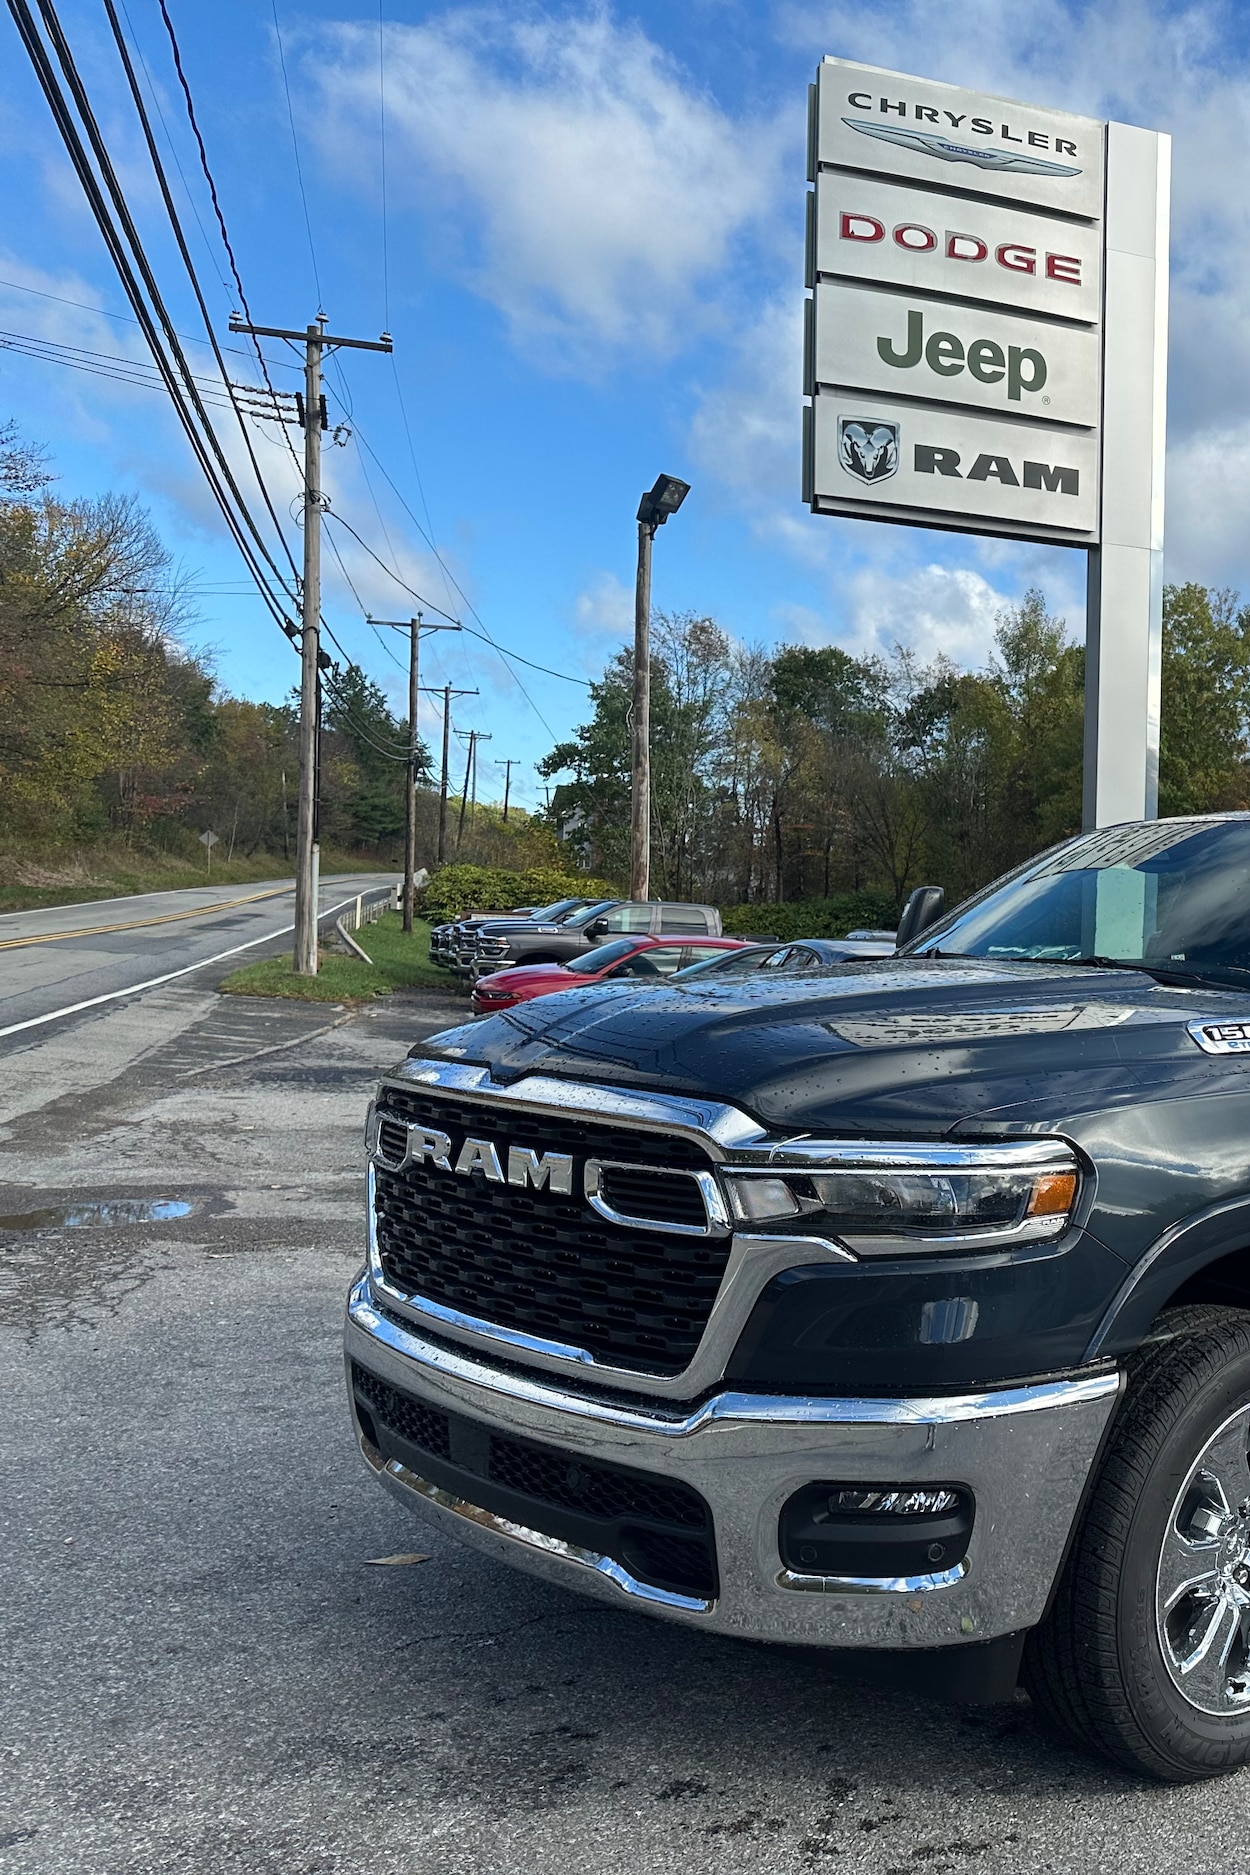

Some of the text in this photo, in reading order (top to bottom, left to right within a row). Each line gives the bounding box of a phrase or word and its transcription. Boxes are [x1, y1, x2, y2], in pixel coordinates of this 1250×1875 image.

[848, 92, 1078, 157] CHRYSLER
[839, 211, 1082, 286] DODGE
[876, 310, 1048, 401] Jeep
[914, 443, 1080, 496] RAM
[410, 1124, 575, 1196] RAM
